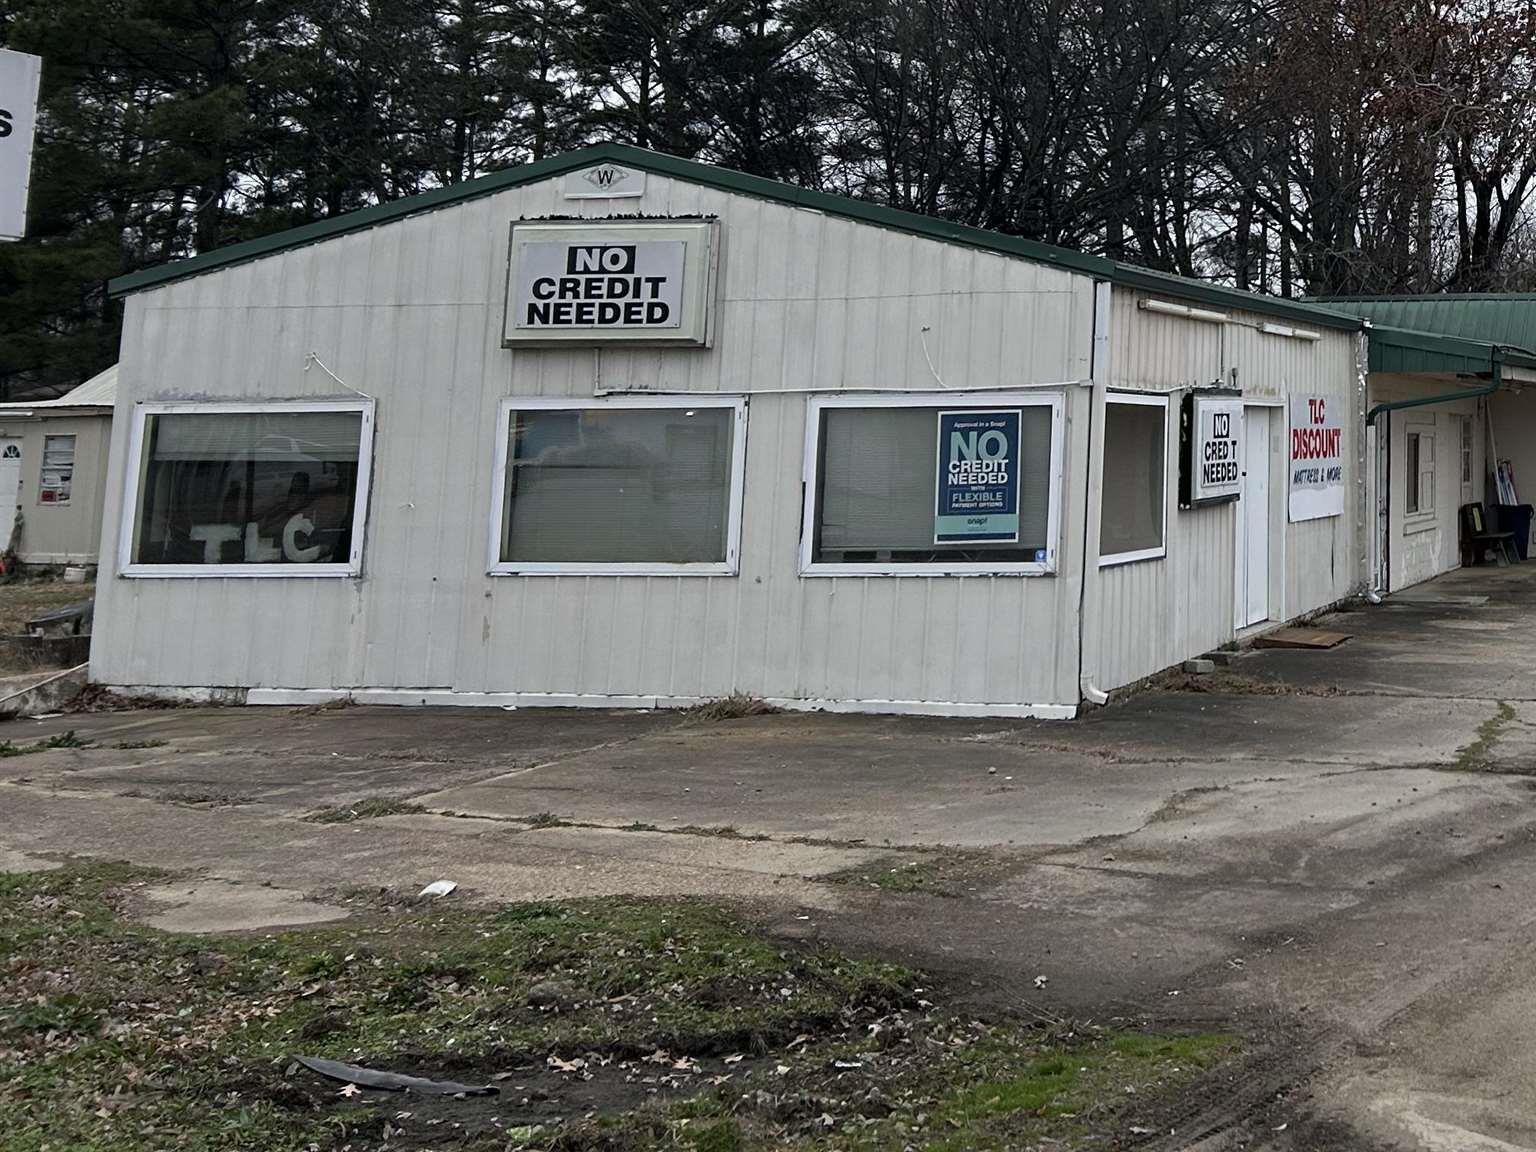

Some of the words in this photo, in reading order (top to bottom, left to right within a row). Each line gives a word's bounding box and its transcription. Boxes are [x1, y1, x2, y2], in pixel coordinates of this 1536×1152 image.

[597, 170, 614, 185] W
[575, 247, 629, 272] NO
[532, 276, 667, 300] CREDIT
[527, 301, 670, 326] NEEDED
[1308, 399, 1326, 425] TLC
[1215, 415, 1228, 437] NO
[950, 430, 1008, 462] NO
[1292, 428, 1341, 460] DISCOUNT
[948, 459, 1009, 474] CREDIT
[948, 472, 1009, 485] NEEDED
[1202, 461, 1238, 485] NEEDED
[952, 492, 1003, 502] FLEXIBLE
[189, 513, 321, 564] TLC
